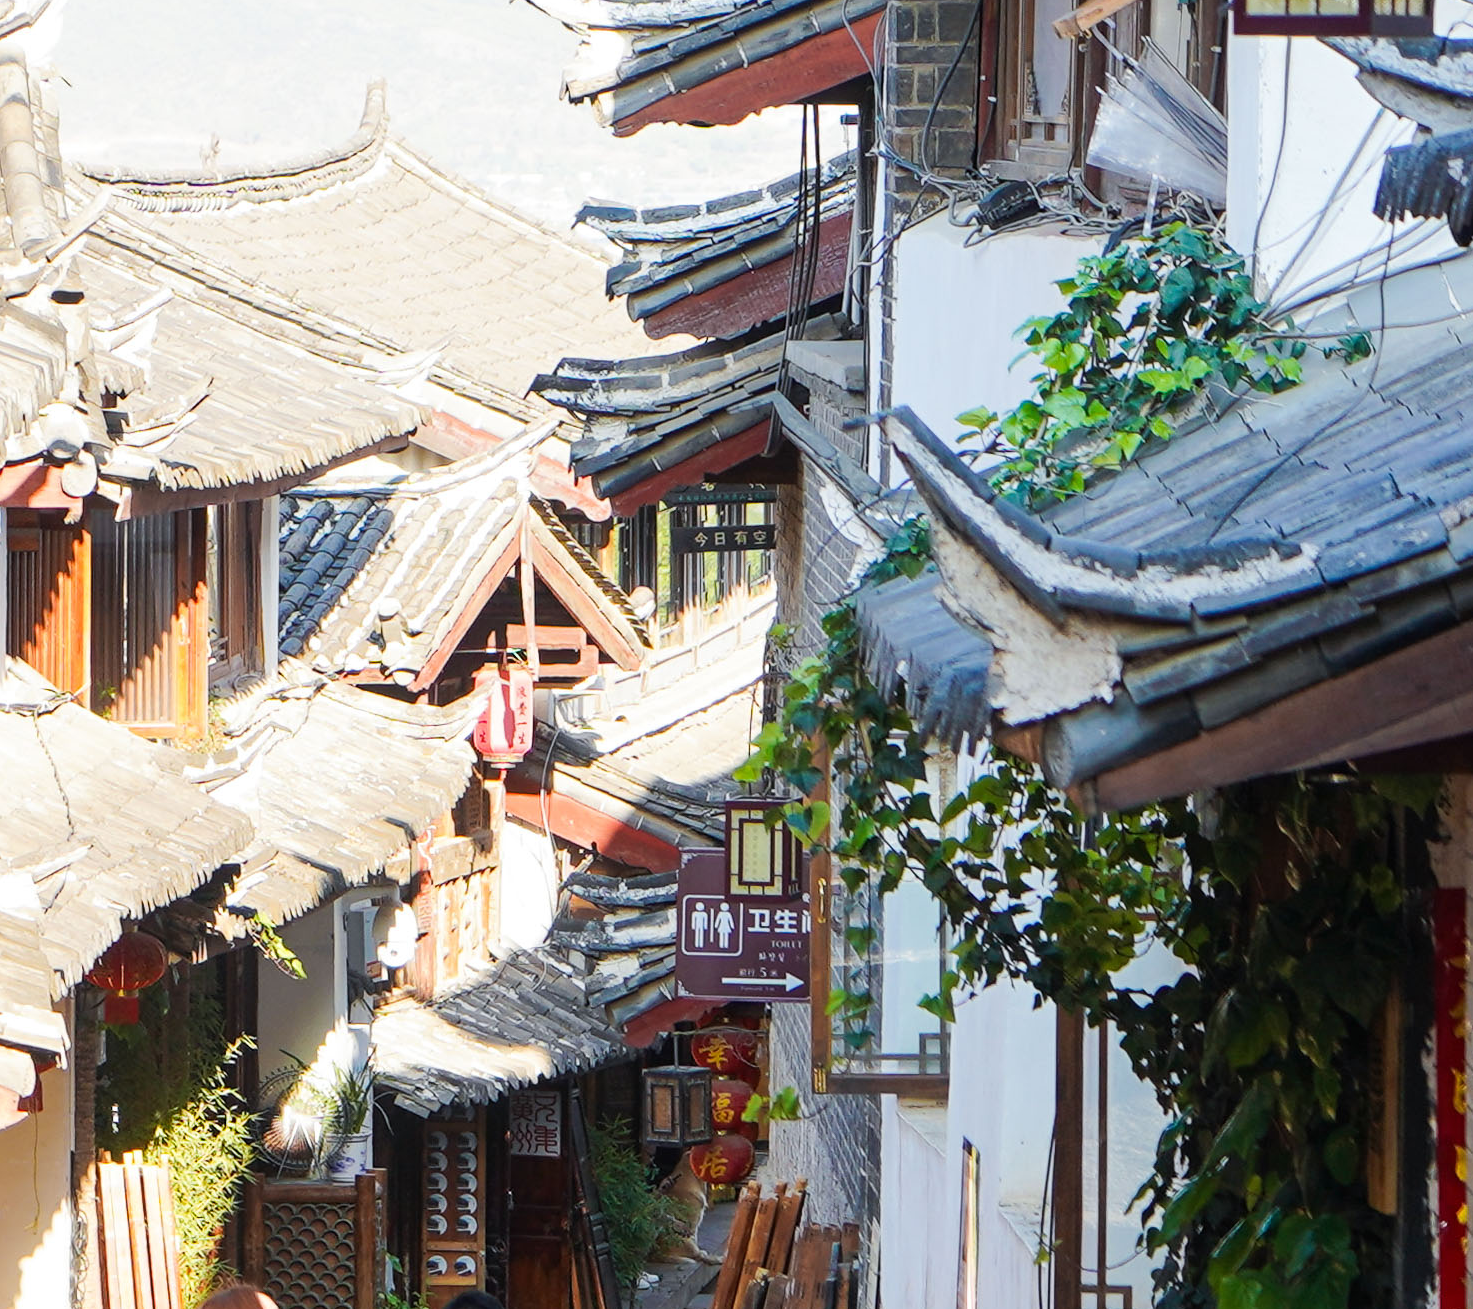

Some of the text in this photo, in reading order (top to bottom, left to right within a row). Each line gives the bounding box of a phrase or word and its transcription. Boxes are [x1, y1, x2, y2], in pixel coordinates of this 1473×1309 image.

[694, 530, 767, 548] 今日有空
[772, 940, 802, 949] TOILET
[759, 967, 768, 978] 5
